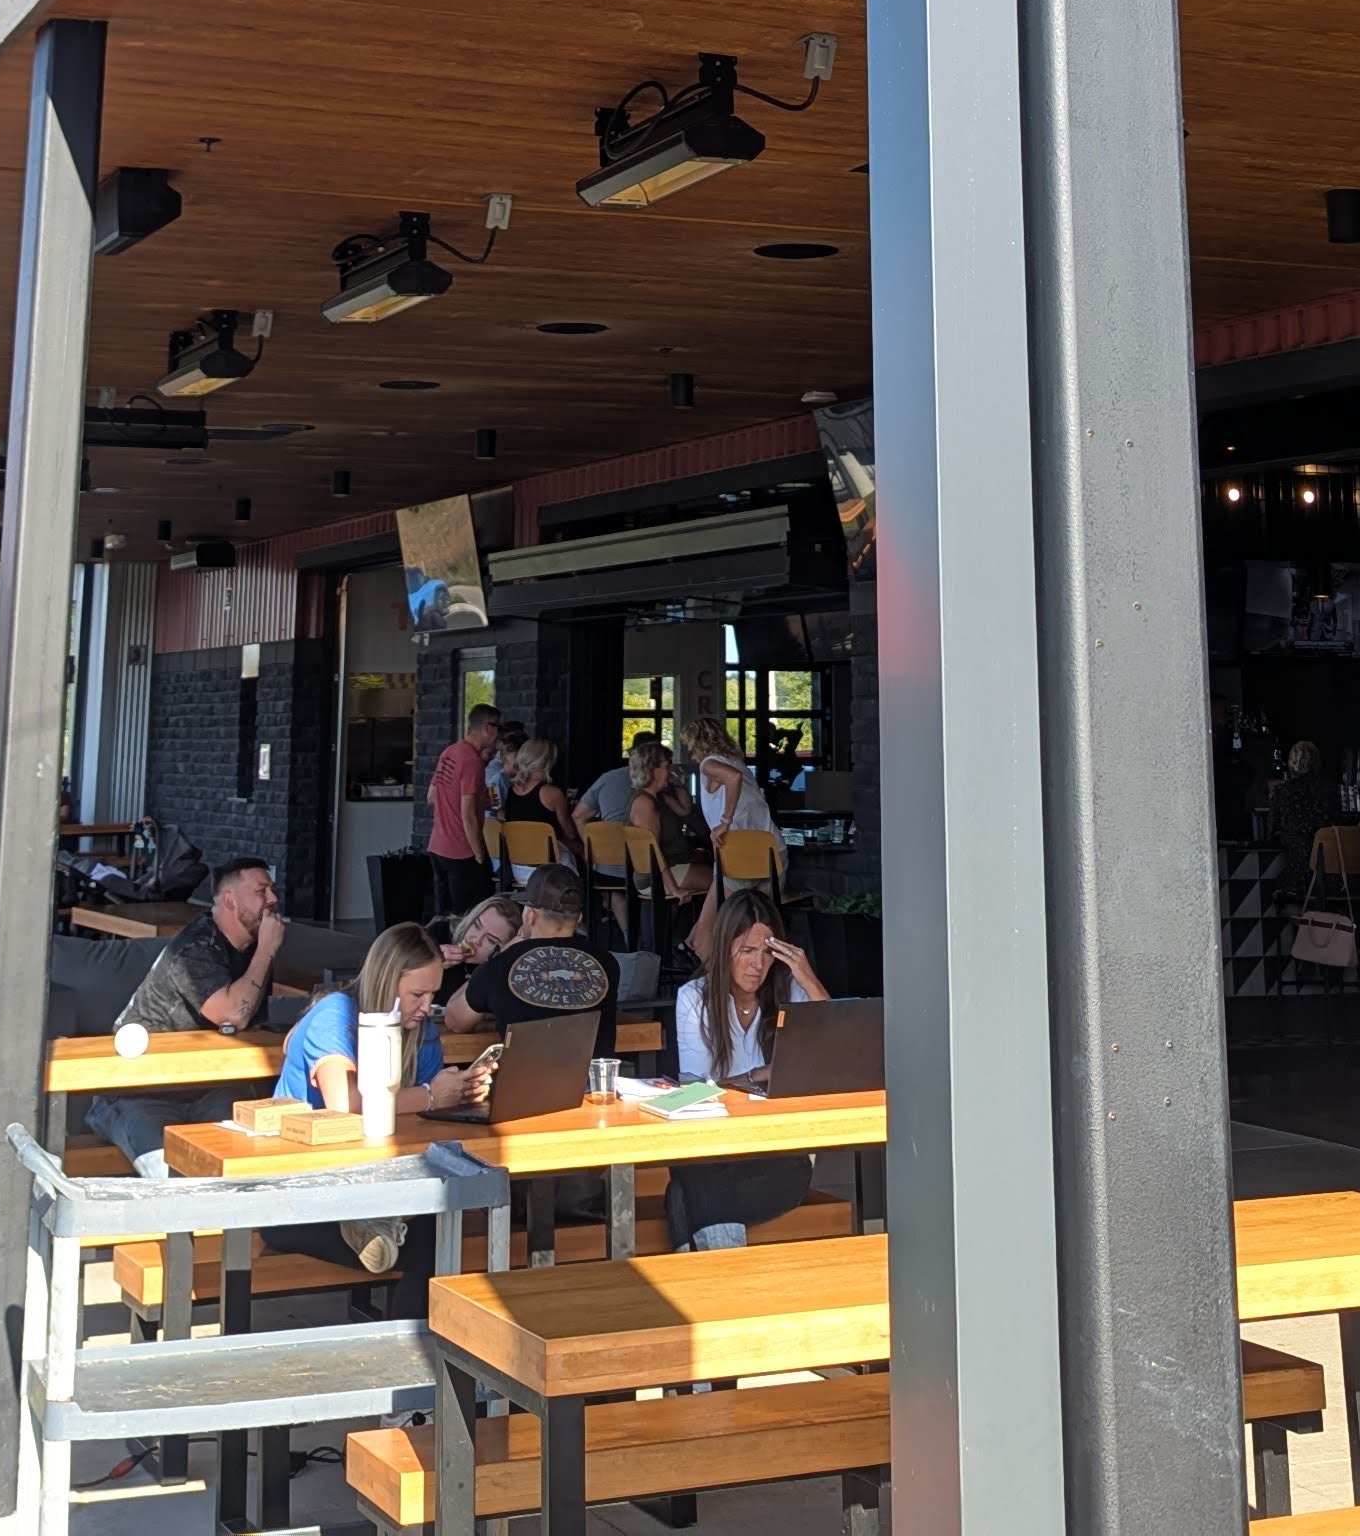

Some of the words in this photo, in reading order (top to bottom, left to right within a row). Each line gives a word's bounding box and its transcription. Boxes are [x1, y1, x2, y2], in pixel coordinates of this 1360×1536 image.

[512, 947, 602, 985] PENDLETON
[524, 986, 570, 1004] SINCE
[579, 984, 603, 1002] 1893
